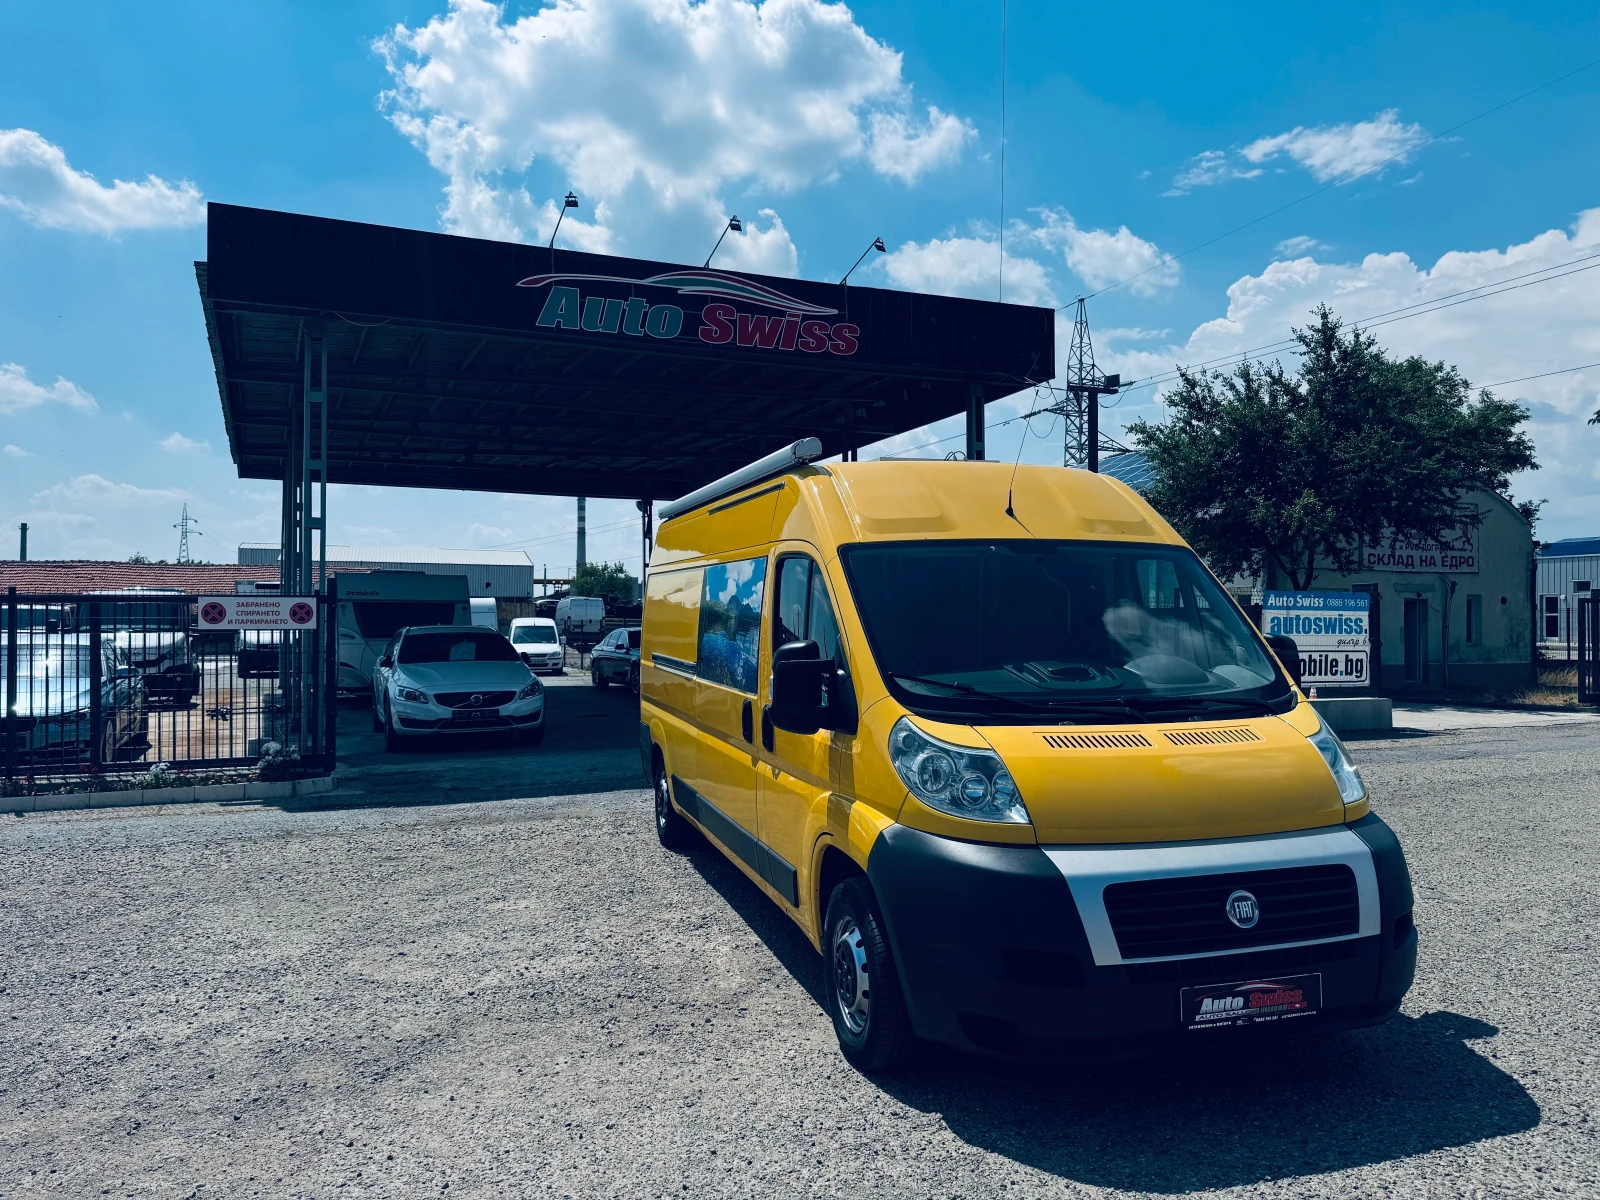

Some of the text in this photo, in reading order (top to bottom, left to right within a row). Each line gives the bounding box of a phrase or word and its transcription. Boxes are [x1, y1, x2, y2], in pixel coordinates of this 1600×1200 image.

[535, 285, 861, 356] Auto Swiss
[1367, 553, 1474, 569] СКЛАД НА ЕДРО
[1268, 594, 1368, 607] Auto Swiss 0888 196 561
[1299, 654, 1364, 679] obile.bg
[1234, 901, 1253, 919] FIAT
[1199, 996, 1244, 1014] Auto
[1248, 989, 1303, 1008] Swiss
[1198, 1013, 1223, 1021] AUTO
